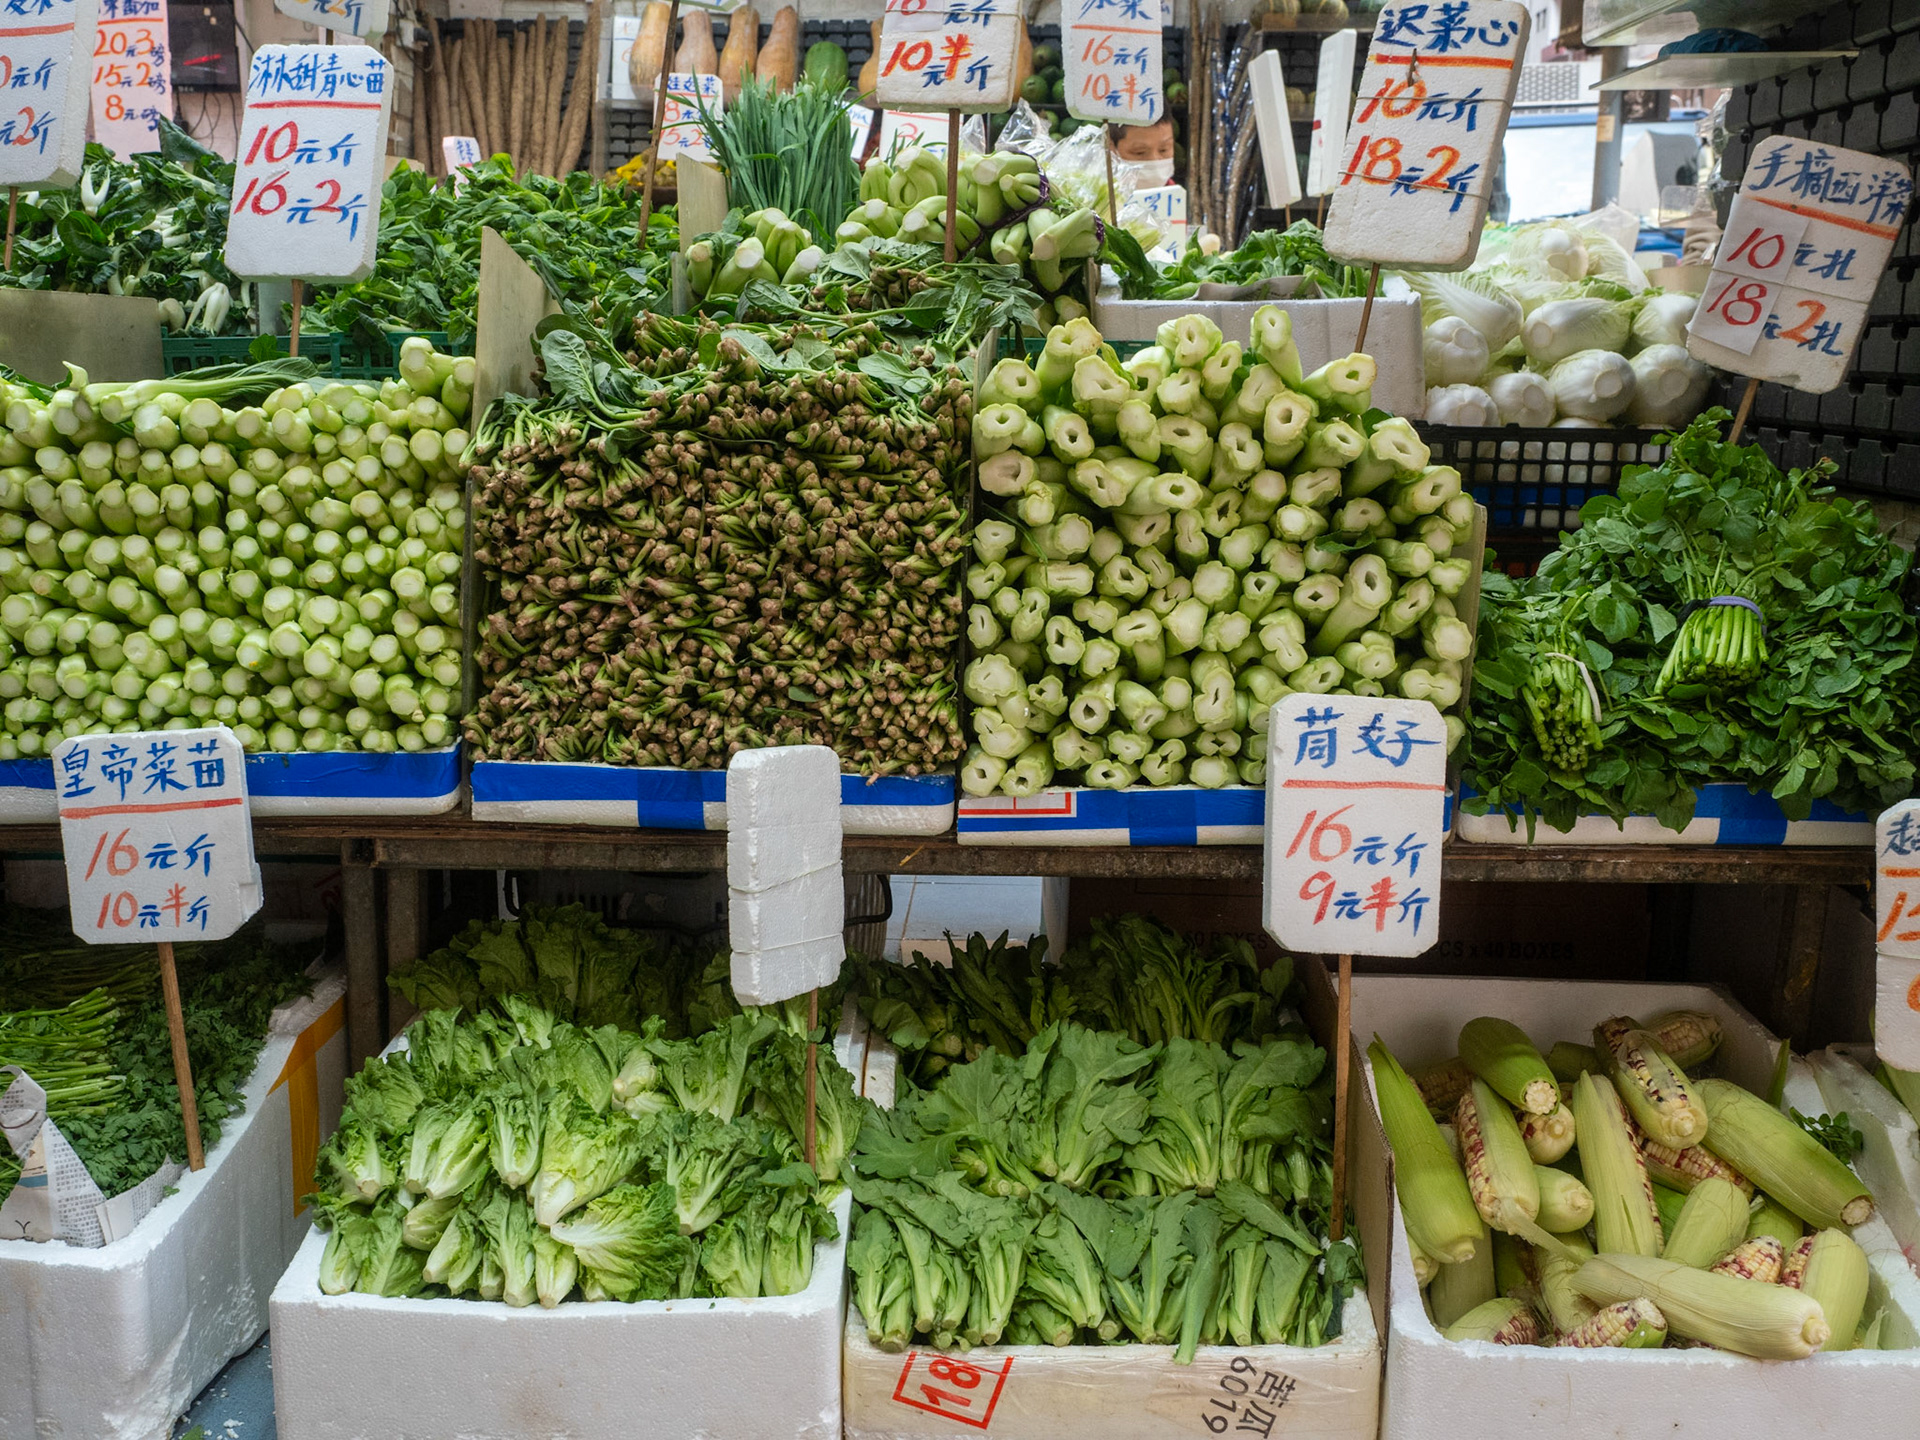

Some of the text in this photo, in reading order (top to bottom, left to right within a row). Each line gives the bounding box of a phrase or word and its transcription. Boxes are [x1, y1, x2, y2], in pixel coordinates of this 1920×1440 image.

[881, 34, 994, 91] 10元半斤
[1081, 34, 1148, 75] 16元斤
[1081, 73, 1158, 120] 10元半斤
[1357, 78, 1482, 132] 10元斤
[244, 121, 361, 167] 10元斤
[1340, 136, 1480, 212] 18元2斤
[233, 171, 368, 242] 16元2斤
[61, 739, 226, 801] 皇帝菜苗
[85, 828, 215, 881] 16元斤
[1286, 804, 1428, 878] 16元斤
[97, 883, 210, 931] 10元半斤
[1299, 871, 1430, 937] 9元半斤
[1508, 941, 1575, 961] BOXES
[1236, 1371, 1296, 1439] 苦瓜
